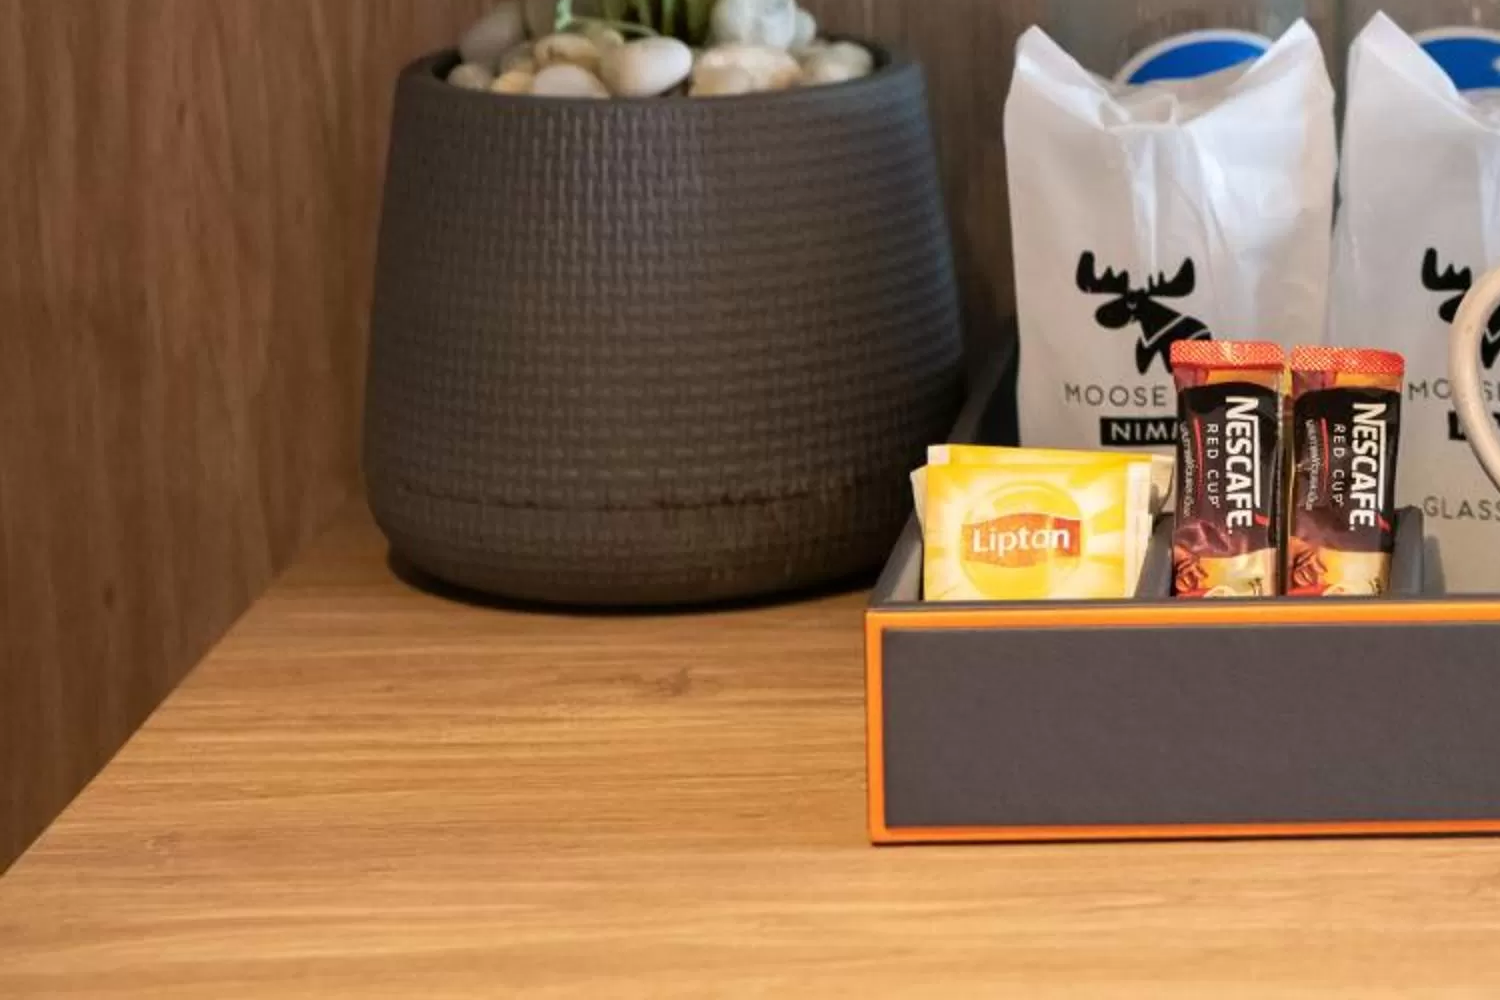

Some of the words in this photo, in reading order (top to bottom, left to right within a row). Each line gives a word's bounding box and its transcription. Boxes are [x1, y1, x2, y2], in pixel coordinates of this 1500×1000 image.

[1064, 383, 1168, 407] MOOSE
[1110, 421, 1178, 441] NIM
[1206, 423, 1220, 460] RED
[1332, 423, 1346, 458] RED
[1206, 469, 1220, 507] CUP
[1331, 470, 1345, 506] CUP
[973, 526, 1071, 557] Lipton
